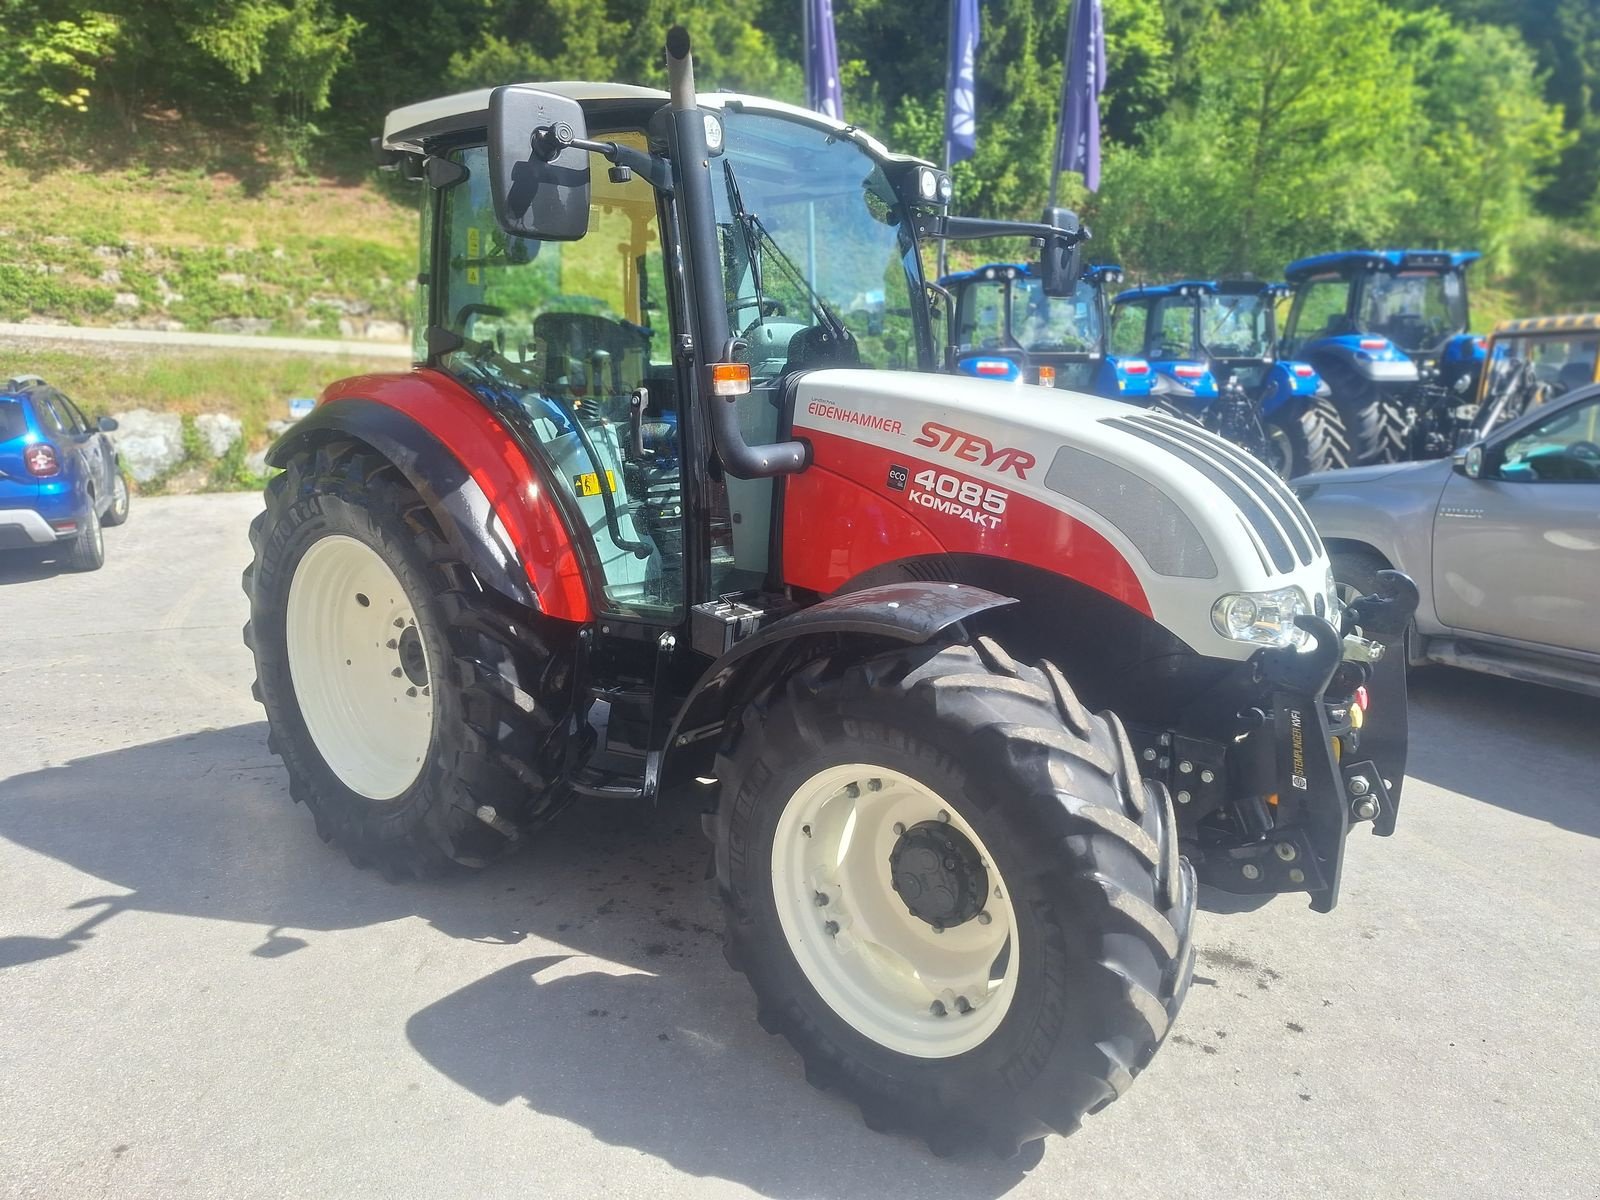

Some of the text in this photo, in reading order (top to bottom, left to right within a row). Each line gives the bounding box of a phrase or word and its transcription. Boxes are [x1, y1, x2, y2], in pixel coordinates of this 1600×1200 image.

[808, 402, 902, 434] EIDENHAMMER
[913, 421, 1036, 481] STEYR
[889, 470, 906, 481] eco
[913, 469, 1009, 514] 4085
[908, 489, 1002, 529] KOMPAKT
